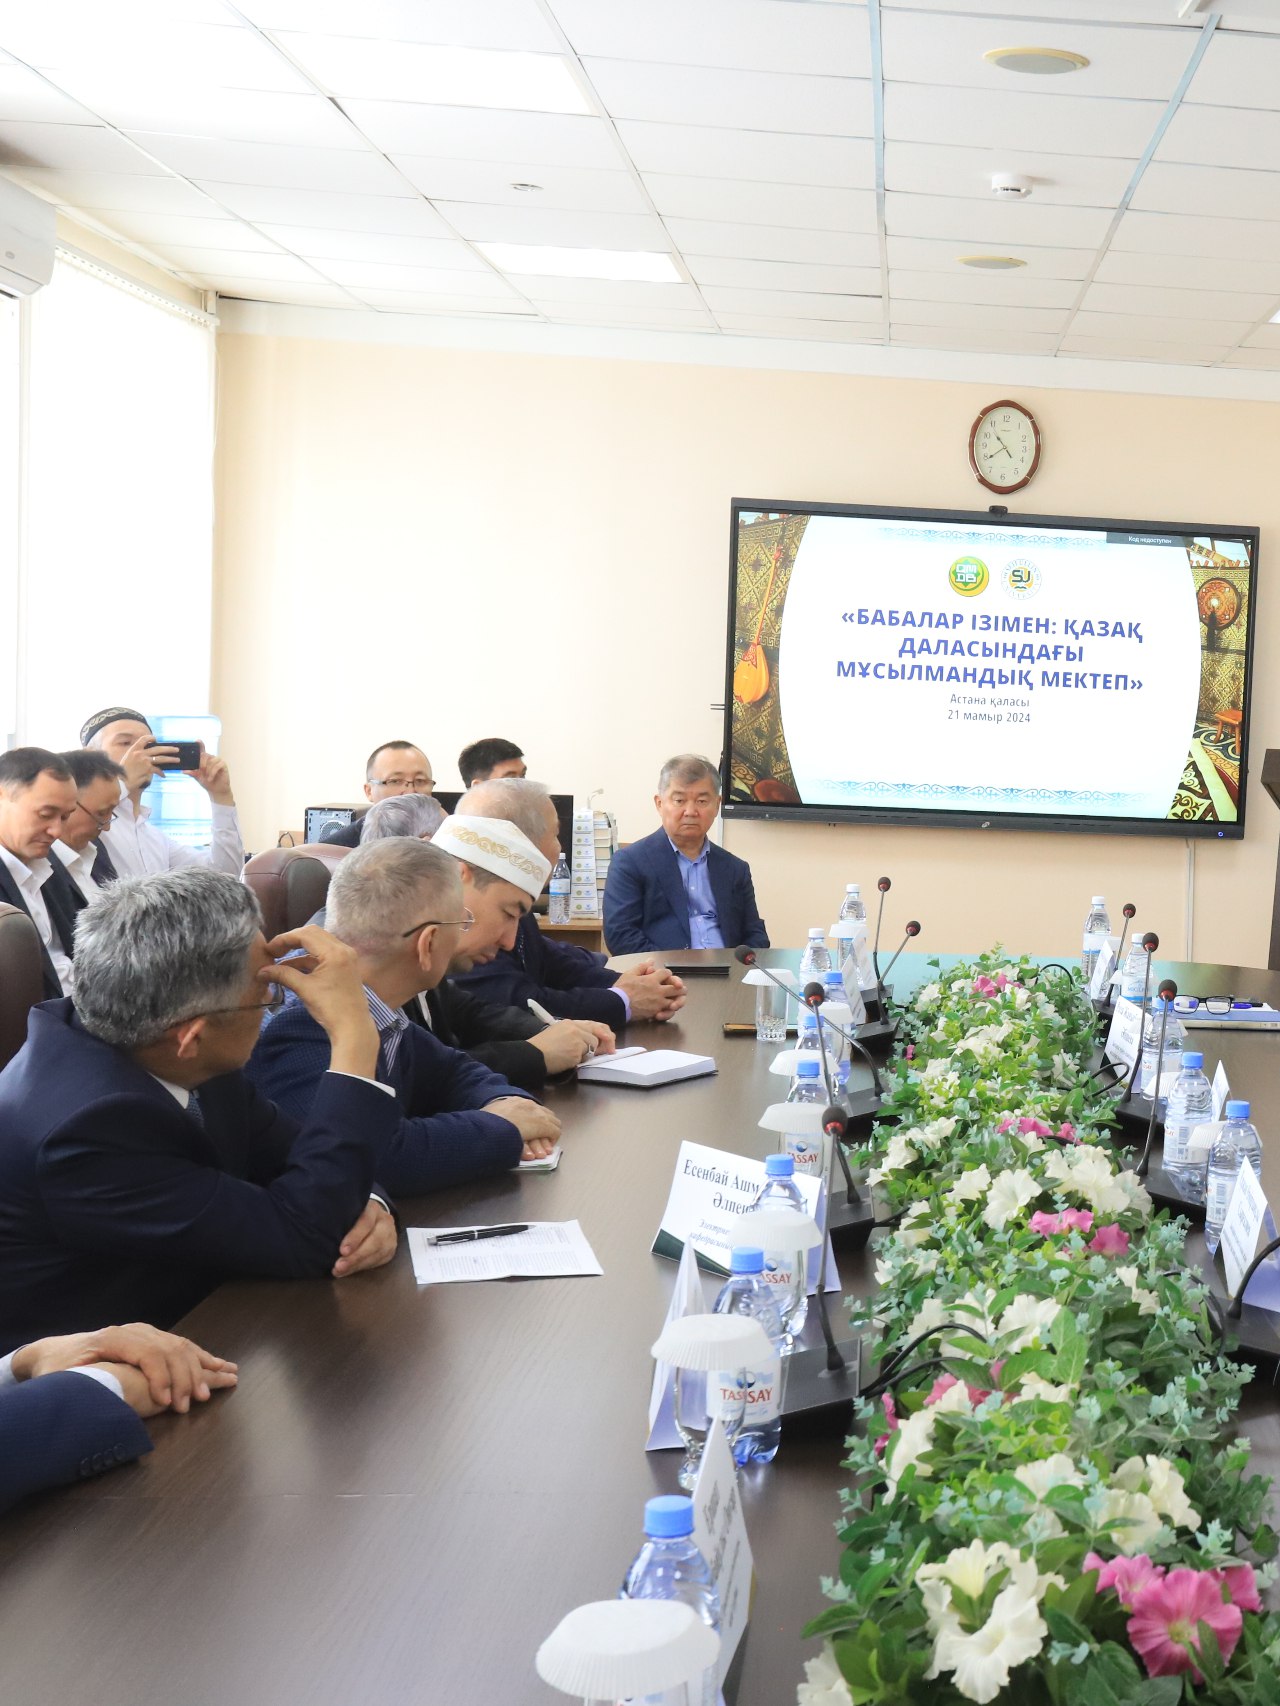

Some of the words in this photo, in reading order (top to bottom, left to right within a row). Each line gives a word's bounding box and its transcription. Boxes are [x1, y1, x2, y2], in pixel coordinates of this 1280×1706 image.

[841, 608, 964, 629] «БАБАЛАР
[971, 613, 1057, 635] ІЗІМЕН:
[1064, 619, 1143, 643] ҚАЗАҚ
[898, 637, 1084, 664] ДАЛАСЫНДАҒЫ
[836, 660, 1034, 691] МҰСЫЛМАНДЫҚ
[1041, 670, 1143, 691] МЕКТЕП»
[950, 693, 986, 705] Астана
[990, 697, 1030, 708] қаласы
[948, 709, 959, 720] 21
[963, 712, 1003, 724] мамыр
[1006, 712, 1031, 723] 2024
[683, 1159, 729, 1186] Есенбай
